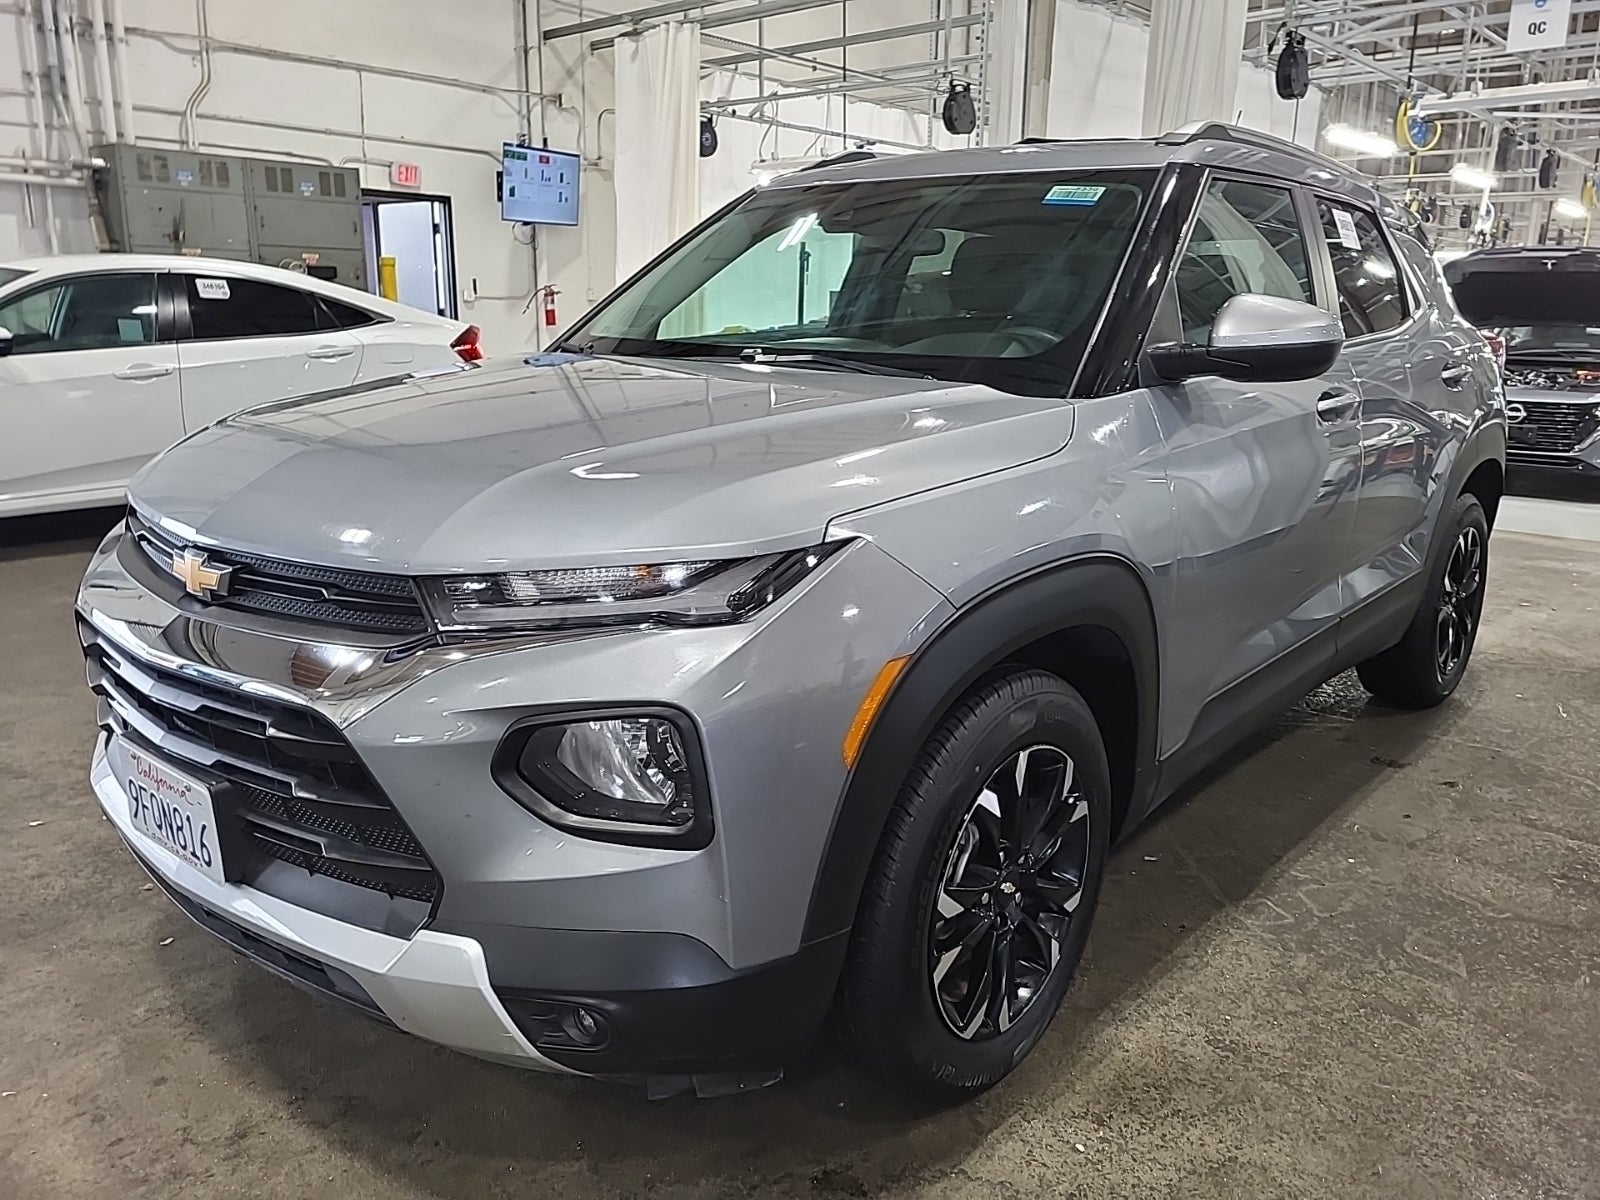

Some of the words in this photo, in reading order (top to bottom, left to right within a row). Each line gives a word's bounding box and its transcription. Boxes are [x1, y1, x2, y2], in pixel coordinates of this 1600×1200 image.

[1528, 21, 1547, 35] QC
[398, 164, 418, 184] EXIT
[135, 757, 194, 806] California
